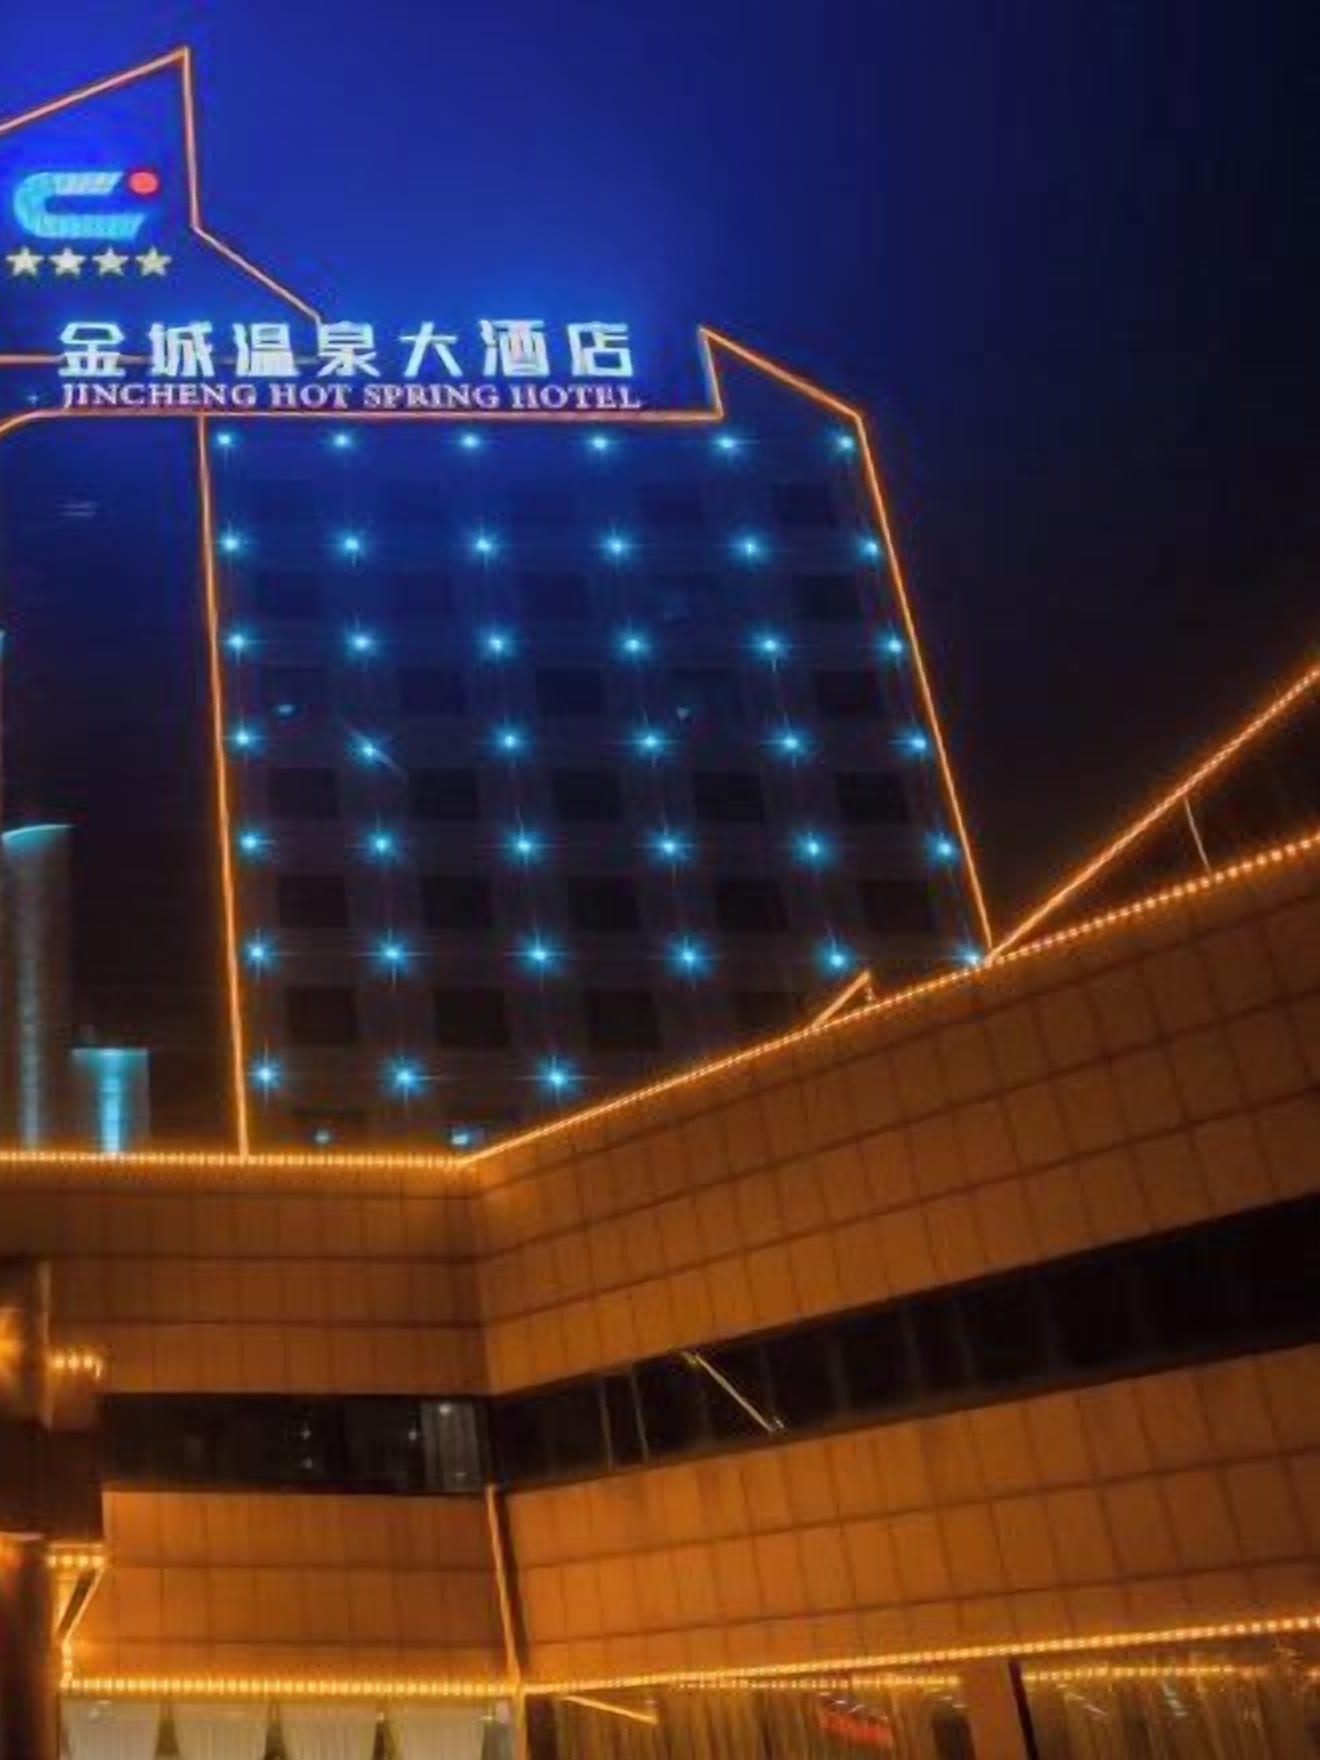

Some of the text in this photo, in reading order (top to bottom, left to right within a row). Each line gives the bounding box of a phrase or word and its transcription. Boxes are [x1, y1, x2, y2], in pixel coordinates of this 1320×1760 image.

[58, 319, 634, 378] 金城温泉大酒店
[62, 383, 642, 410] JINCHENG HOT SPRING HOTEL
